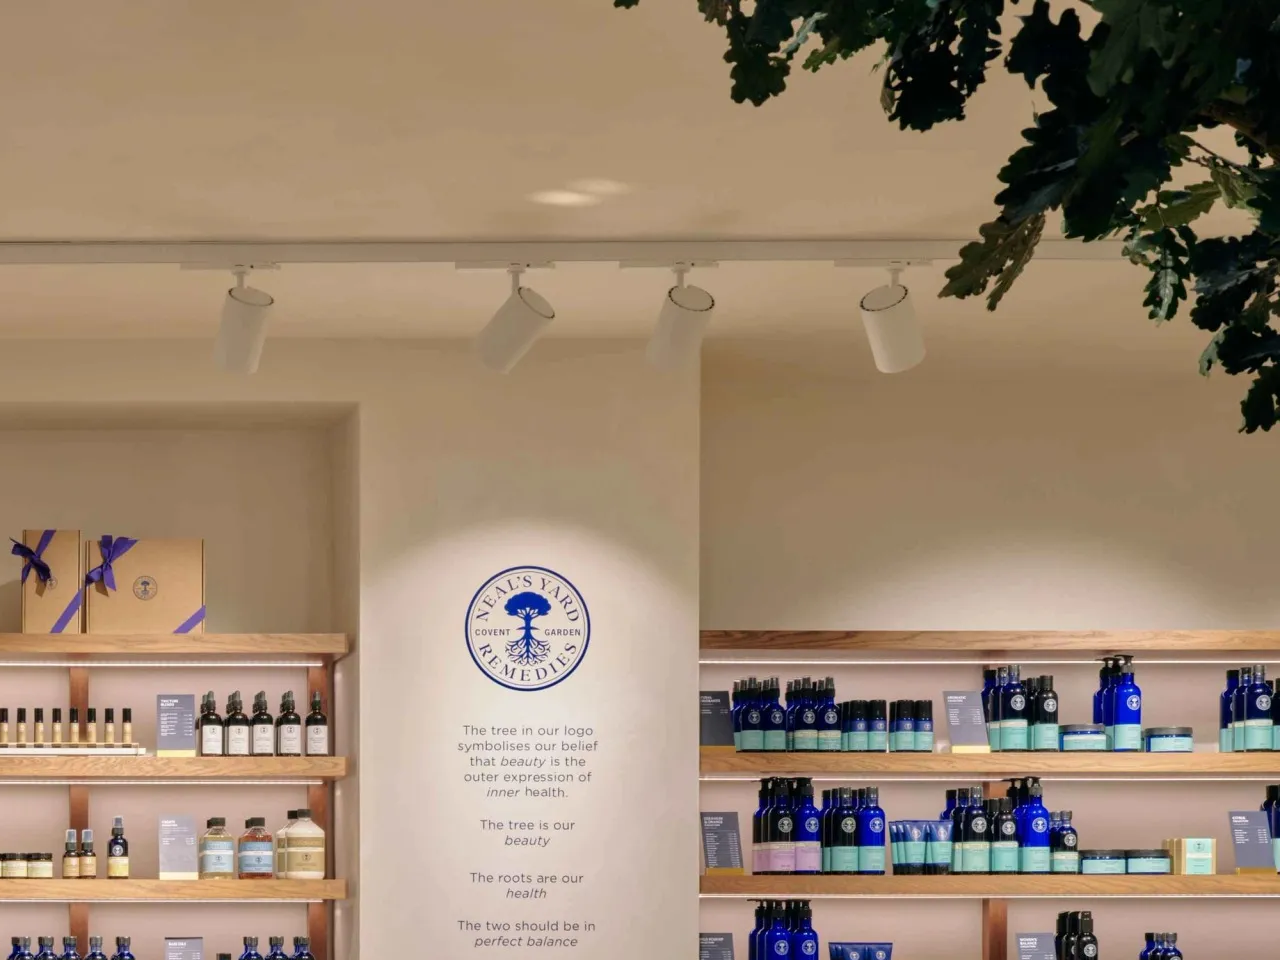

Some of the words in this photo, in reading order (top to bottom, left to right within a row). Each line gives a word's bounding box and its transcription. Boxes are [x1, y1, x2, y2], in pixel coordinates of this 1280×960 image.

[476, 575, 533, 622] NEAL'S
[540, 577, 580, 622] YARD
[479, 643, 577, 682] REMEDIES
[463, 725, 486, 735] The
[491, 726, 517, 735] tree
[521, 725, 533, 735] in
[538, 728, 559, 736] our
[565, 725, 593, 737] logo
[458, 740, 530, 753] symbolises
[535, 743, 556, 751] our
[562, 740, 598, 751] belief
[470, 756, 496, 766] that
[501, 756, 546, 768] beauty
[551, 756, 560, 766] is
[565, 756, 586, 767] the
[464, 772, 499, 782] outer
[504, 772, 573, 783] expression
[578, 772, 592, 782] of
[487, 787, 520, 797] inner
[525, 786, 568, 797] health.
[480, 819, 504, 830] The
[509, 820, 534, 830] tree
[539, 820, 549, 830] is
[554, 822, 575, 830] our
[505, 835, 550, 847] beauty
[470, 872, 494, 883] The
[499, 873, 532, 883] roots
[537, 875, 557, 884] are
[562, 875, 584, 883] our
[506, 888, 546, 898] health
[457, 920, 481, 931] The
[486, 921, 510, 932] two
[515, 921, 558, 931] should
[564, 921, 579, 931] be
[585, 921, 595, 932] in
[474, 936, 523, 948] perfect
[527, 936, 578, 947] balance
